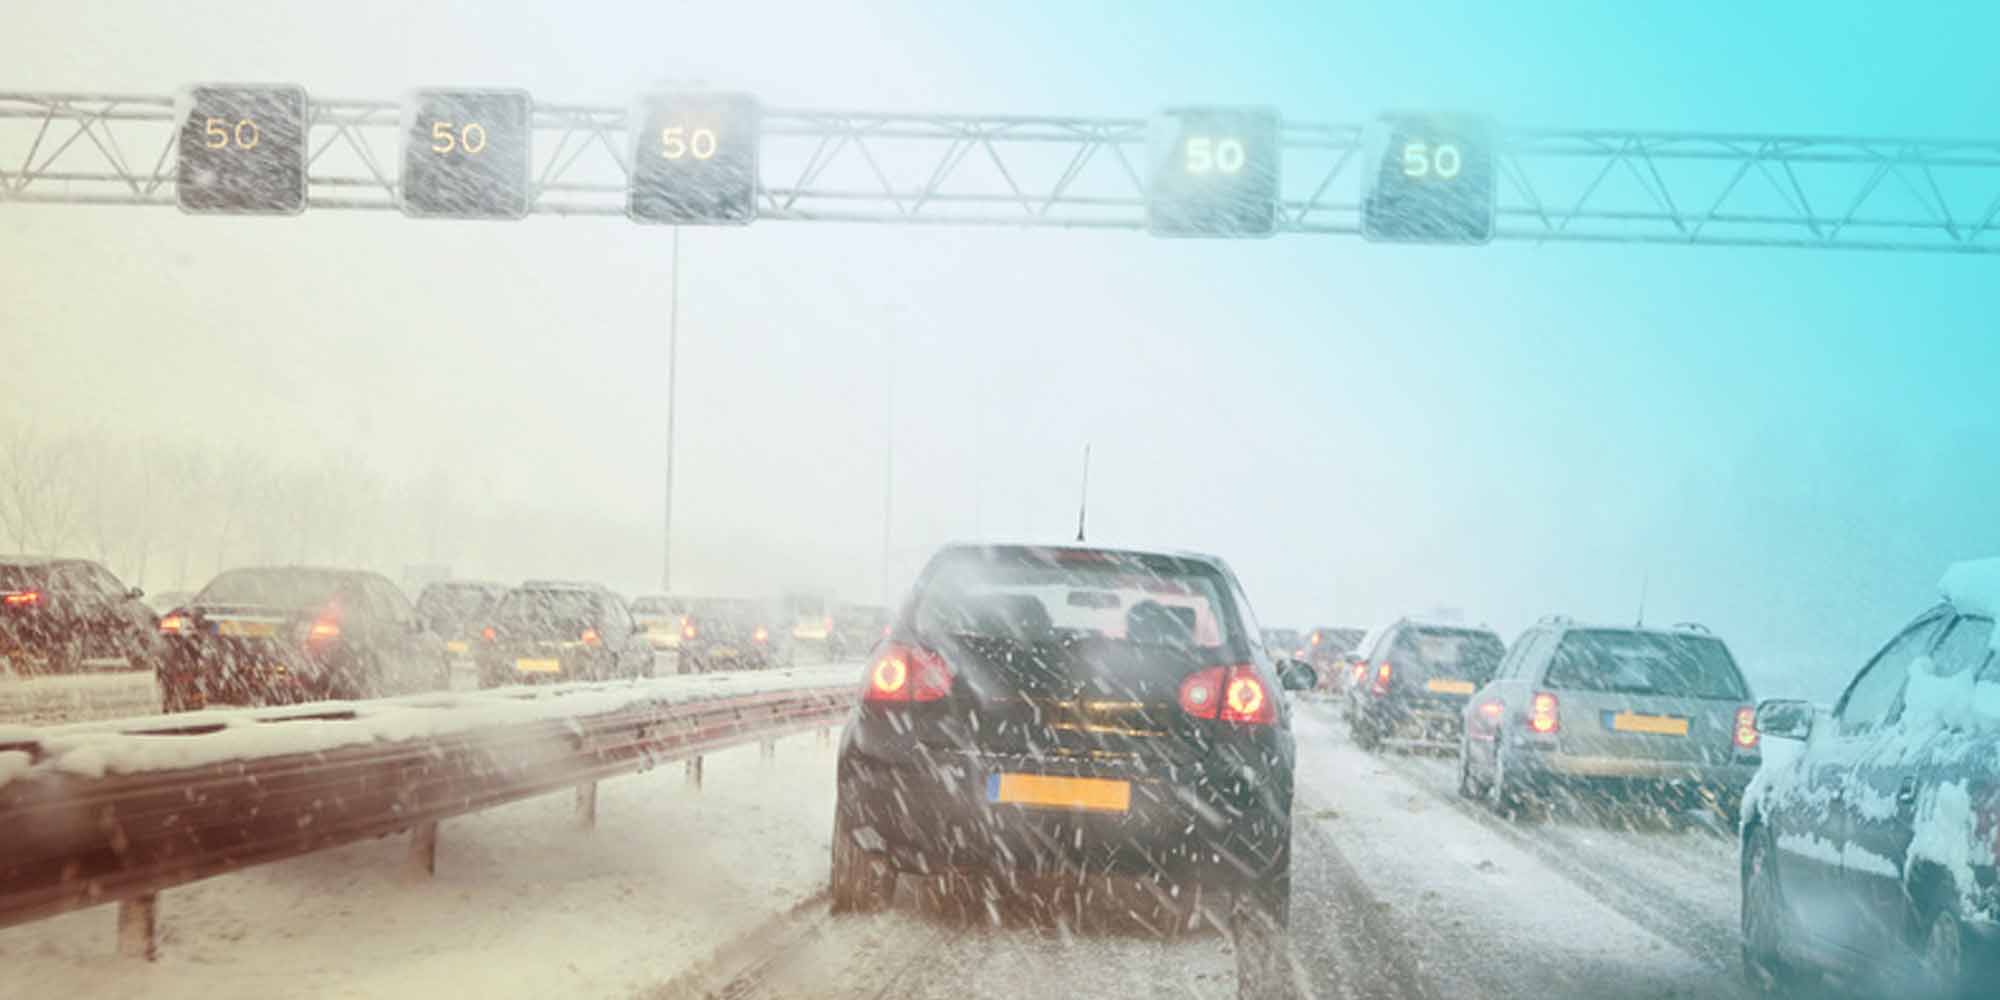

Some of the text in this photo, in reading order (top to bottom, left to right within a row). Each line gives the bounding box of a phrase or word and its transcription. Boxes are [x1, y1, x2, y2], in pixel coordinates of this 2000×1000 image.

[207, 117, 258, 149] 50
[432, 121, 486, 153] 50
[662, 128, 716, 160] 50
[1186, 138, 1244, 174] 50
[1404, 144, 1461, 177] 50
